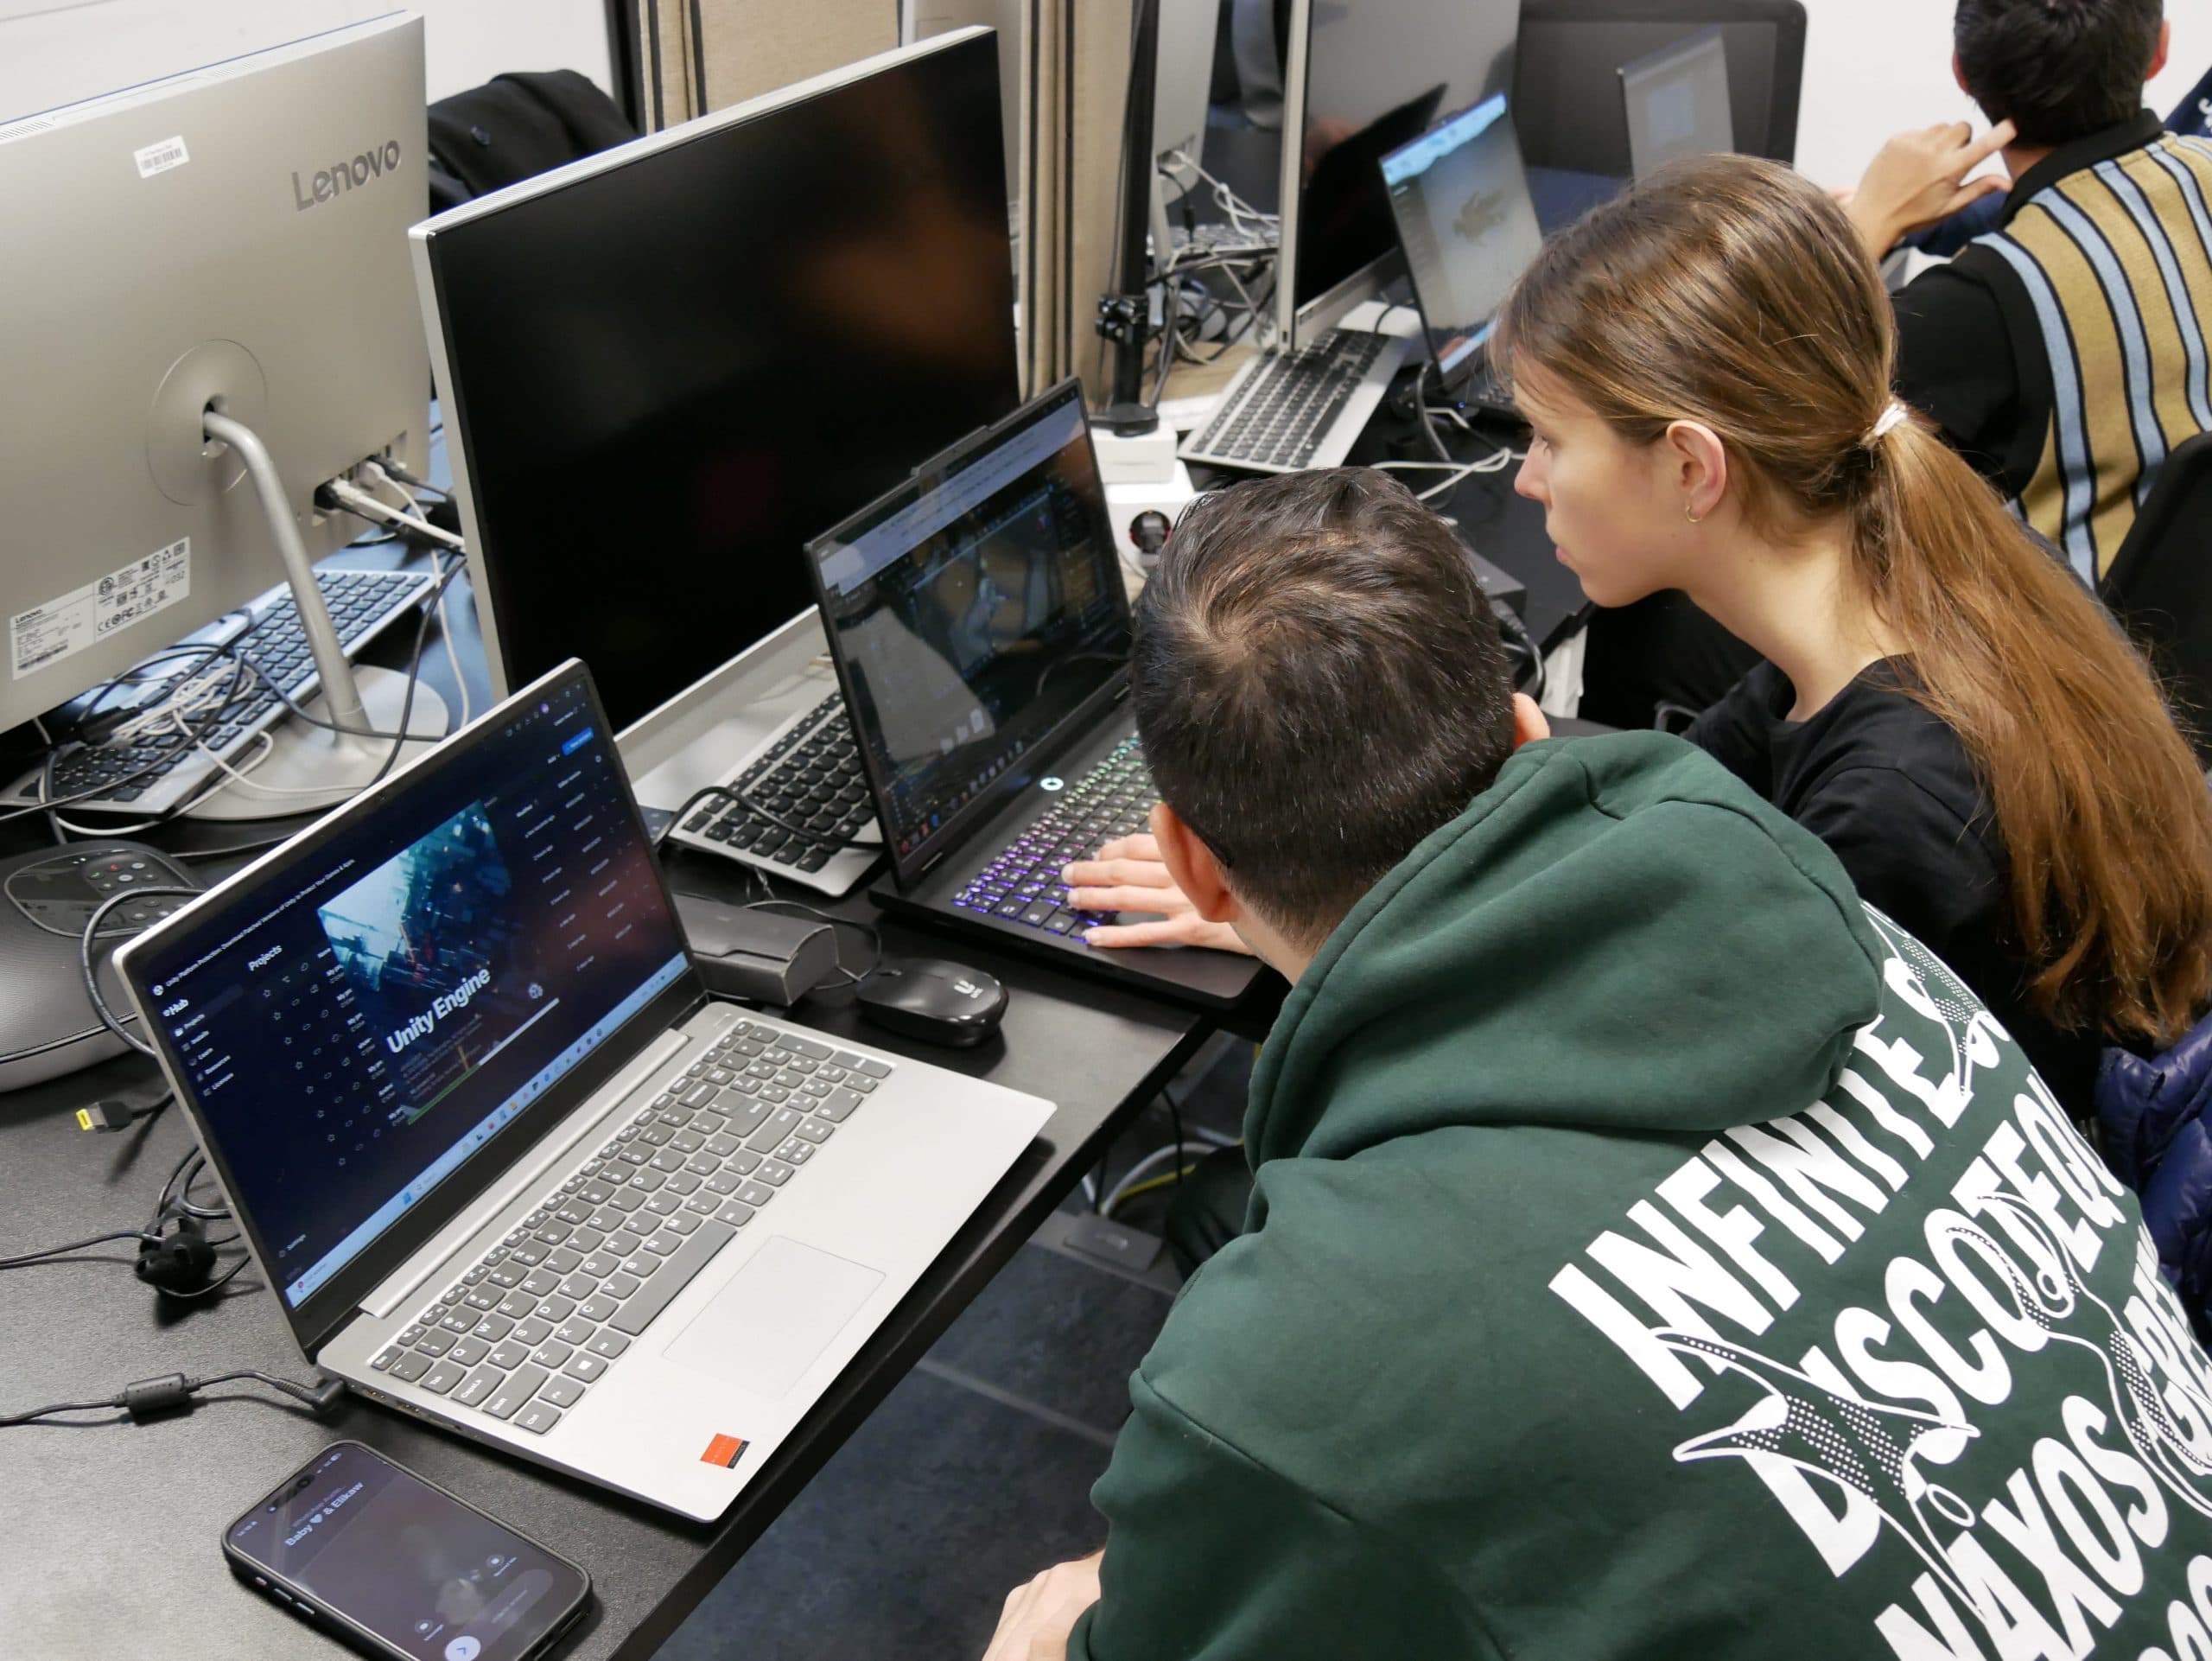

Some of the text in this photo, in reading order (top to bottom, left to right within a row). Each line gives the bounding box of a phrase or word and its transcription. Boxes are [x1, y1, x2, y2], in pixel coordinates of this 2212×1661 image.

[291, 139, 401, 213] Lenovo
[247, 945, 283, 971] Projects
[167, 998, 189, 1015] Hub
[386, 969, 491, 1053] Unity Engine
[284, 1524, 314, 1546] Baby
